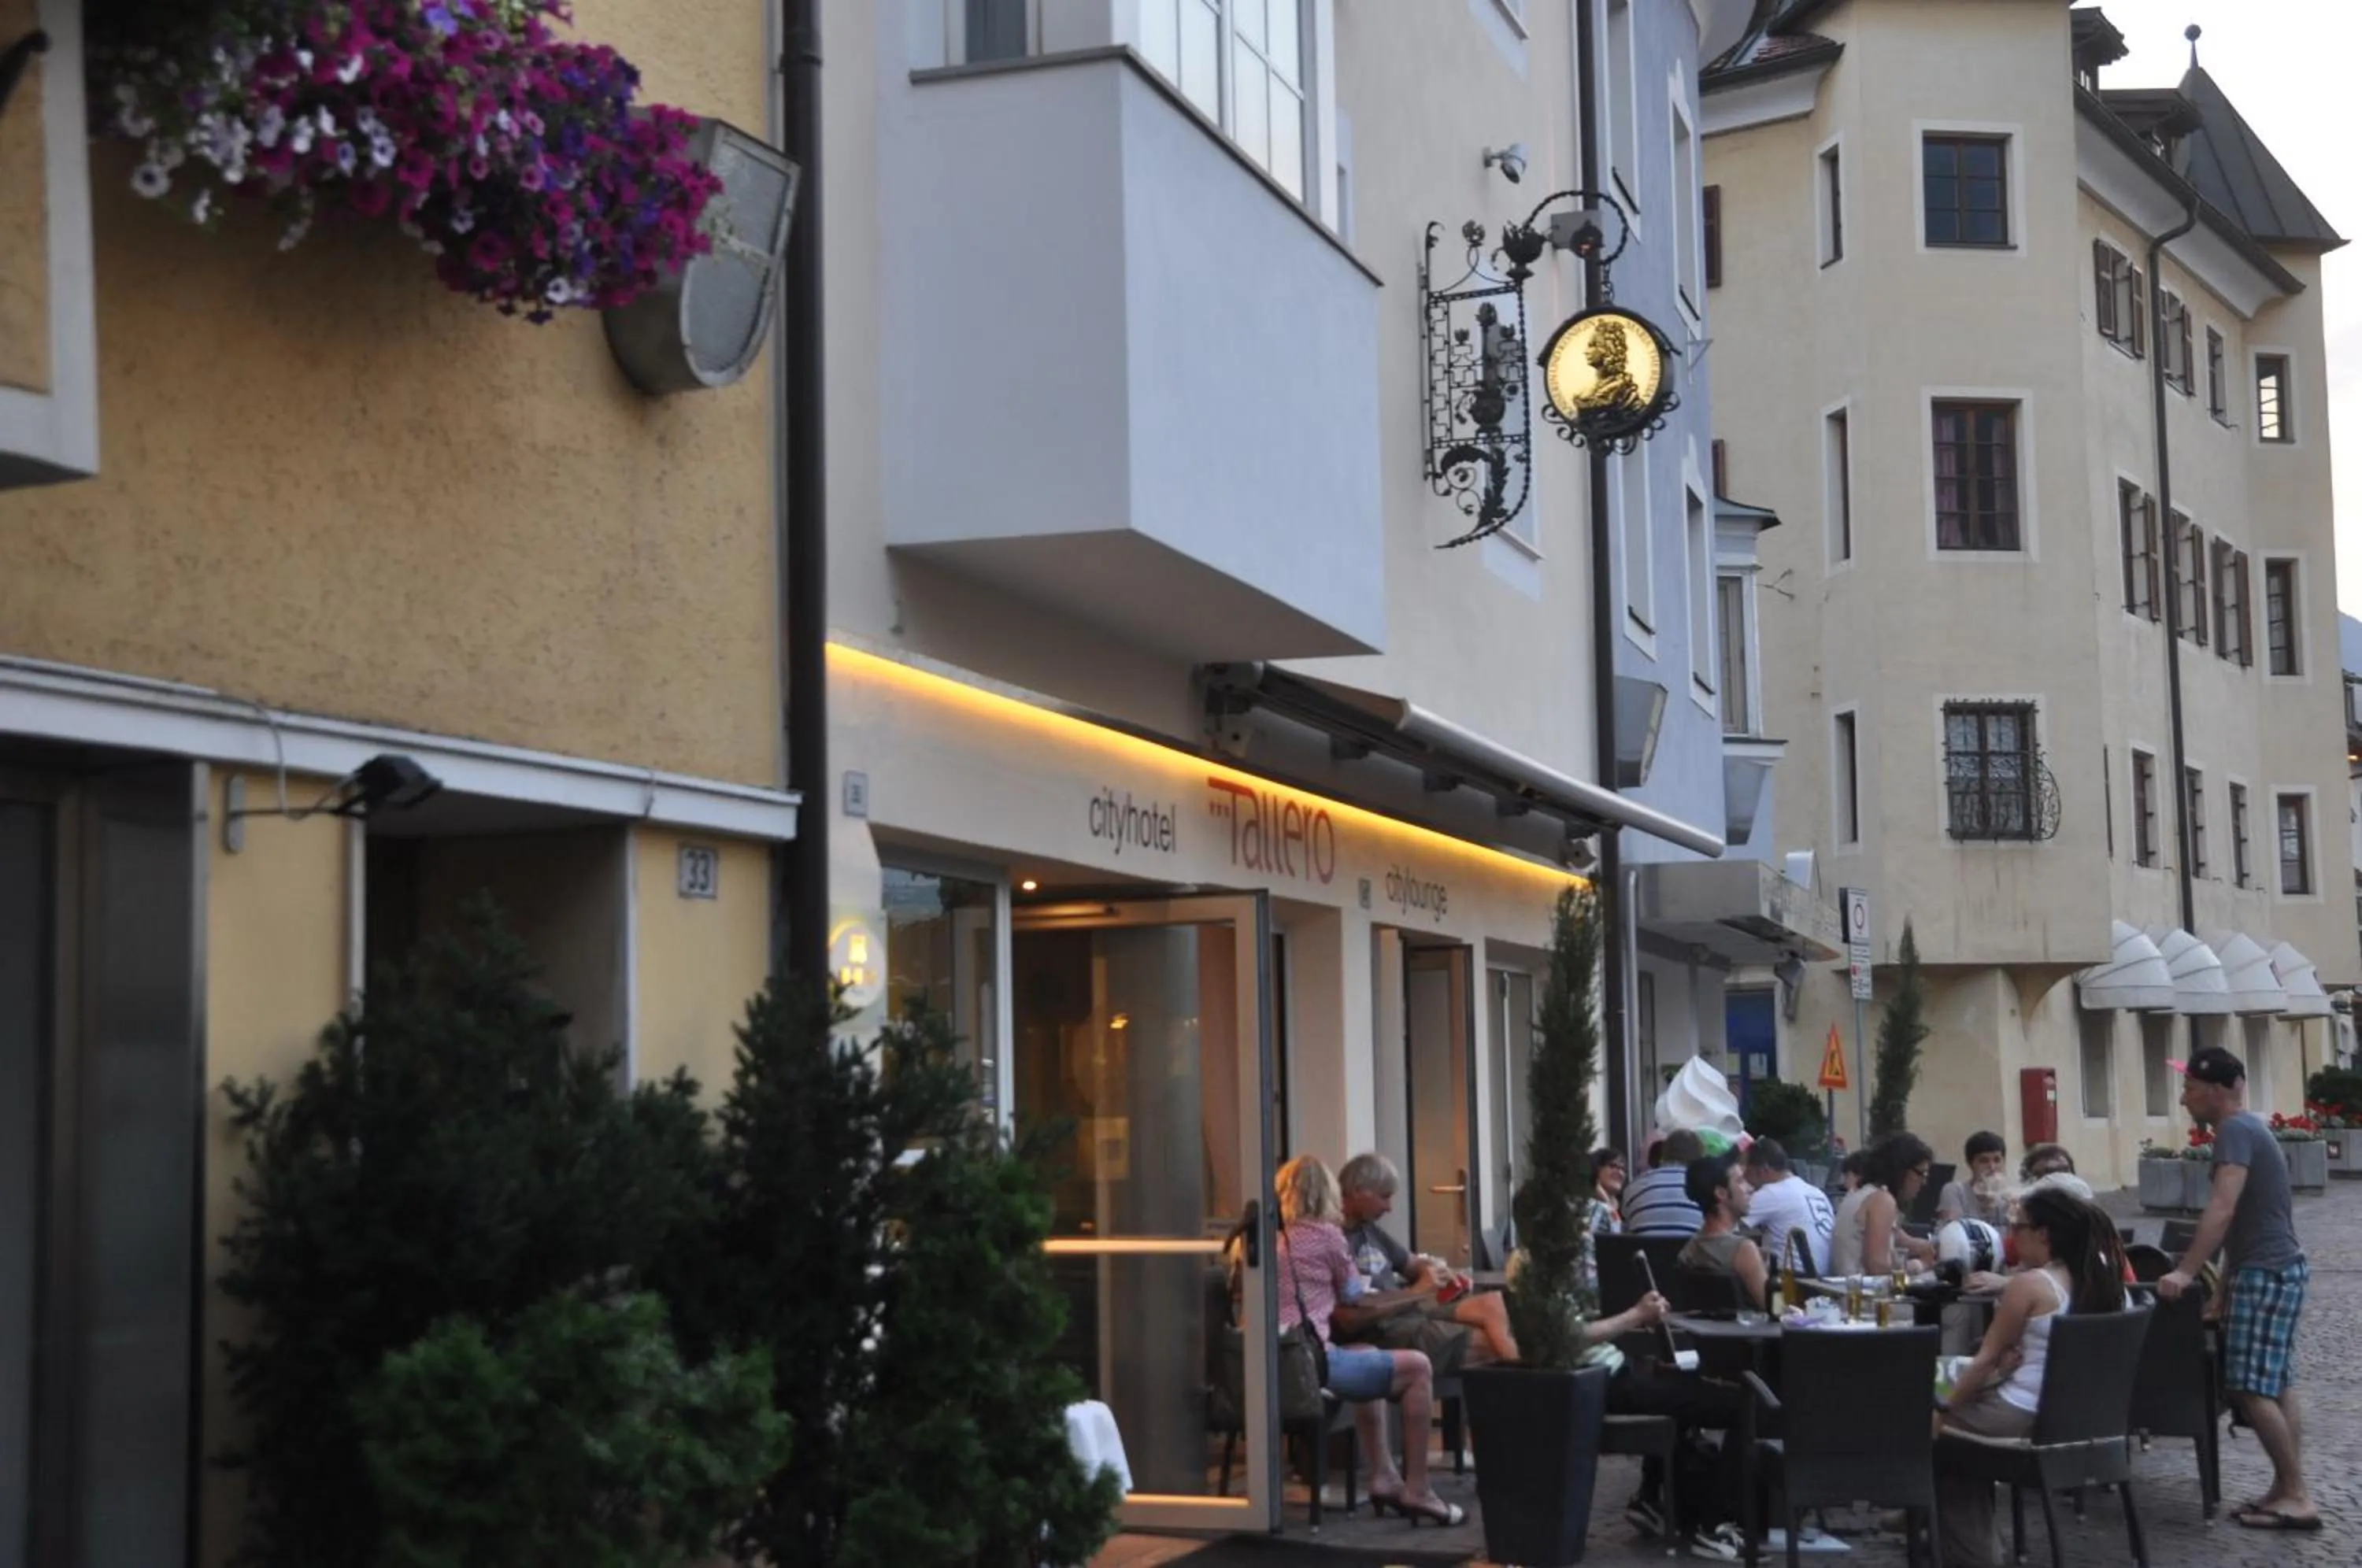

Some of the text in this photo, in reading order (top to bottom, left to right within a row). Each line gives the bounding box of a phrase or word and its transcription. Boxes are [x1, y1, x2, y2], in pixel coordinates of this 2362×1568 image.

[1089, 776, 1335, 886] cityhotel Tallero
[1386, 863, 1448, 923] citylounge
